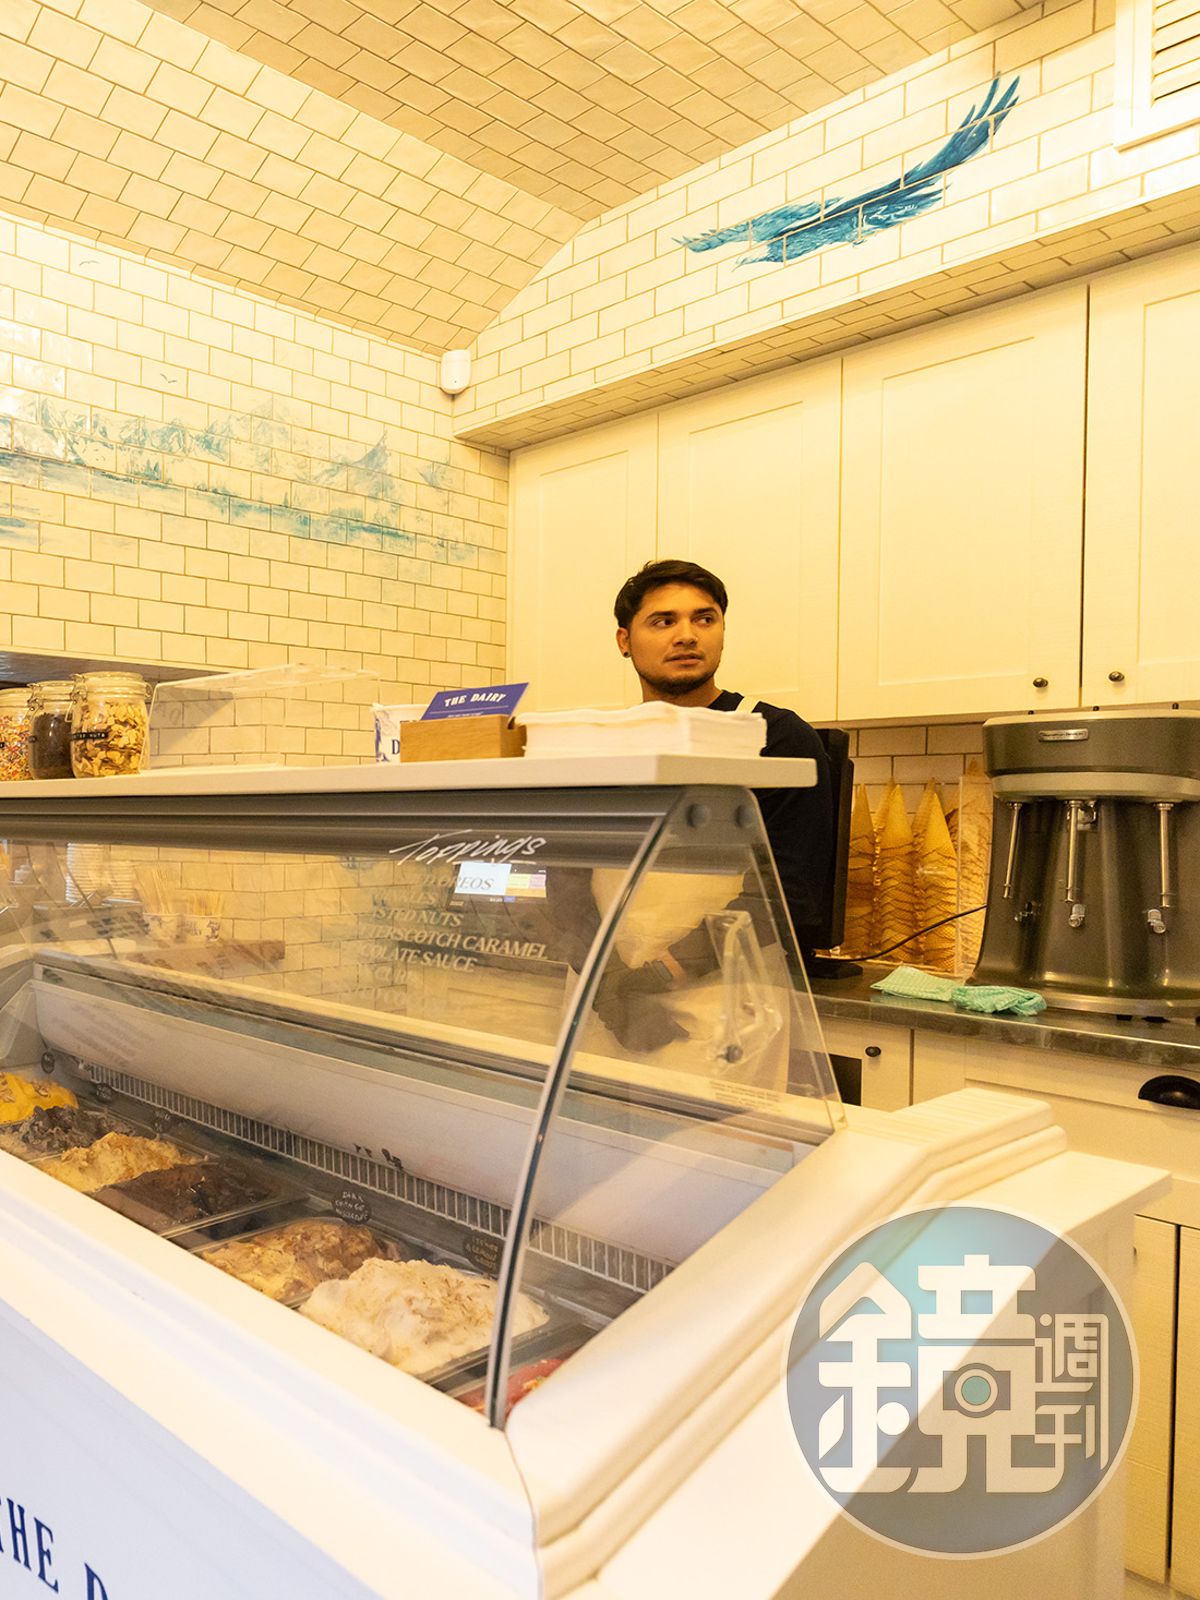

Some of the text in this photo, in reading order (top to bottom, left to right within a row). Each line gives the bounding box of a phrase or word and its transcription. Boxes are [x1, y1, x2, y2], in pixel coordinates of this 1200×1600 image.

[444, 692, 506, 707] THE DAIRY
[389, 829, 547, 865] Toppings
[417, 910, 464, 927] NUTS
[462, 935, 549, 960] CARAMEL
[420, 951, 478, 972] SAUCE
